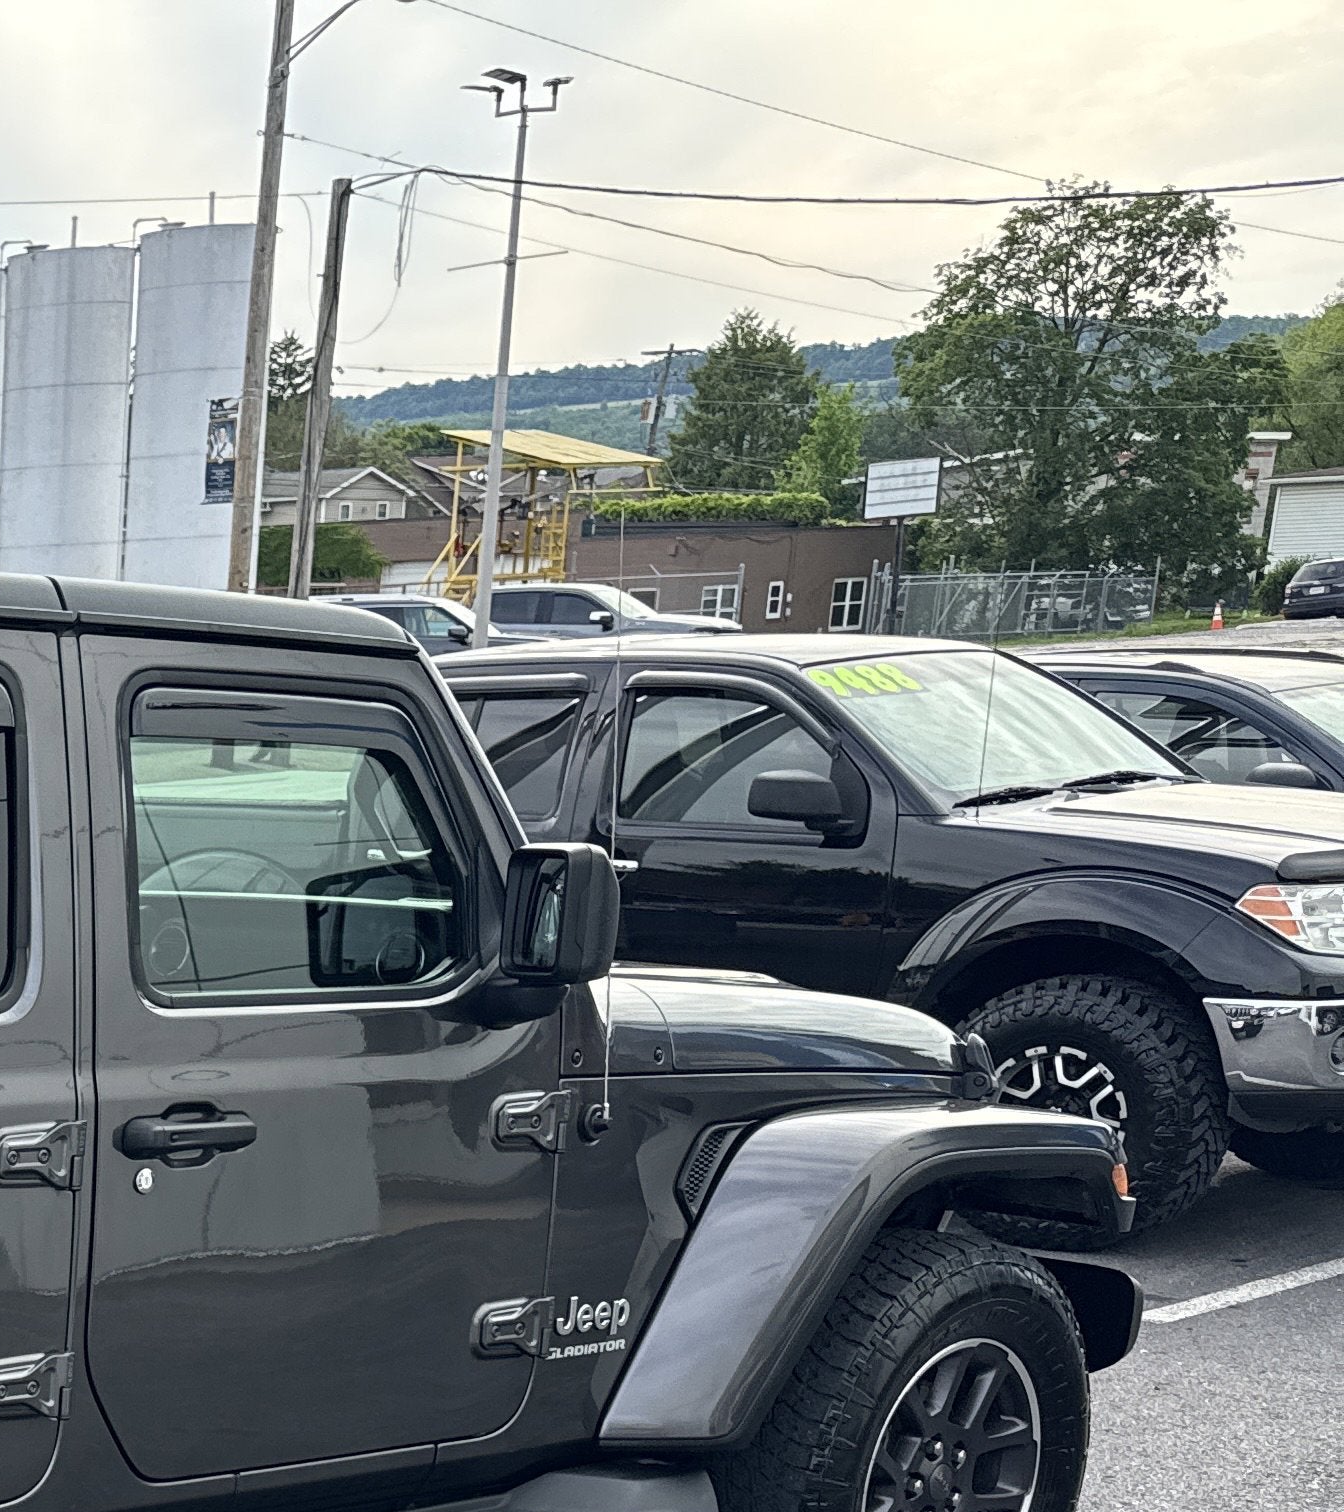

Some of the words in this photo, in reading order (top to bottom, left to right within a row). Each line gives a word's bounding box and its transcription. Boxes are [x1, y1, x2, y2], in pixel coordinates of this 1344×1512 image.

[807, 663, 924, 698] 9488
[556, 1296, 631, 1336] Jeep
[546, 1338, 625, 1360] GLADIATOR
